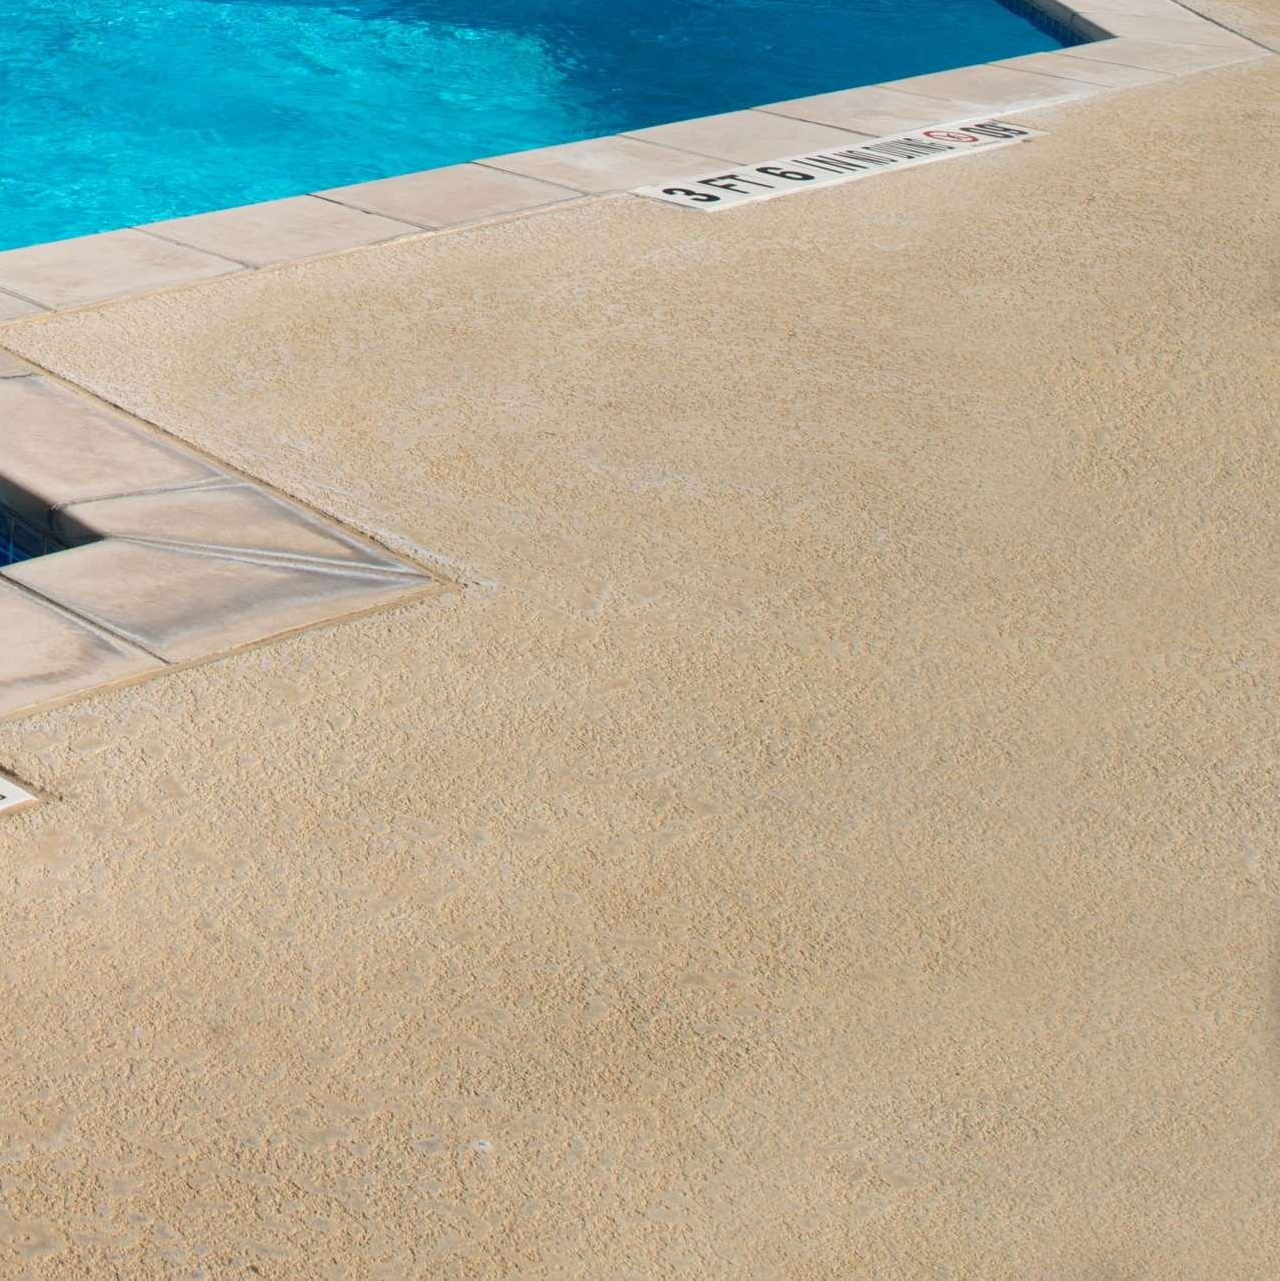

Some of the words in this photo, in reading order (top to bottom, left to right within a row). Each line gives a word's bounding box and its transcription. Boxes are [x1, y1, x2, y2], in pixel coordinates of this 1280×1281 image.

[662, 187, 720, 203] 3
[697, 173, 775, 195] FT
[755, 166, 816, 181] 6
[791, 155, 869, 174] IN
